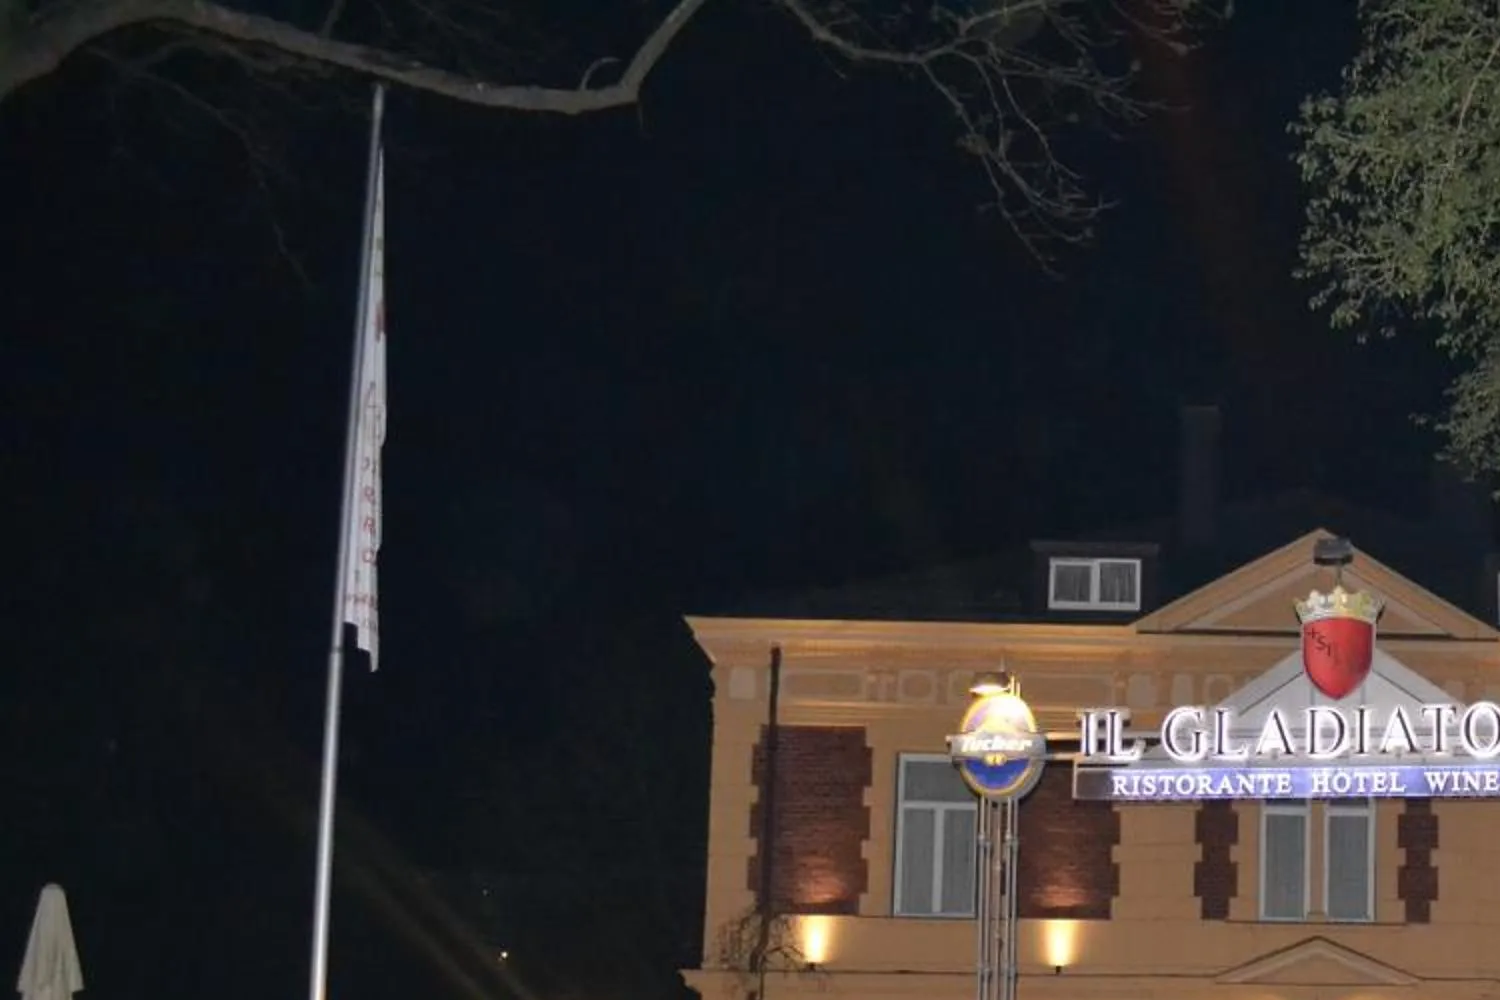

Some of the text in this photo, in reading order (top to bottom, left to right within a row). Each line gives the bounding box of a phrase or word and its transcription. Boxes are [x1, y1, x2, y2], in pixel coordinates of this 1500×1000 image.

[1079, 708, 1145, 761] IL
[1112, 773, 1292, 796] RISTORANTE
[1312, 768, 1407, 794] HOTEL
